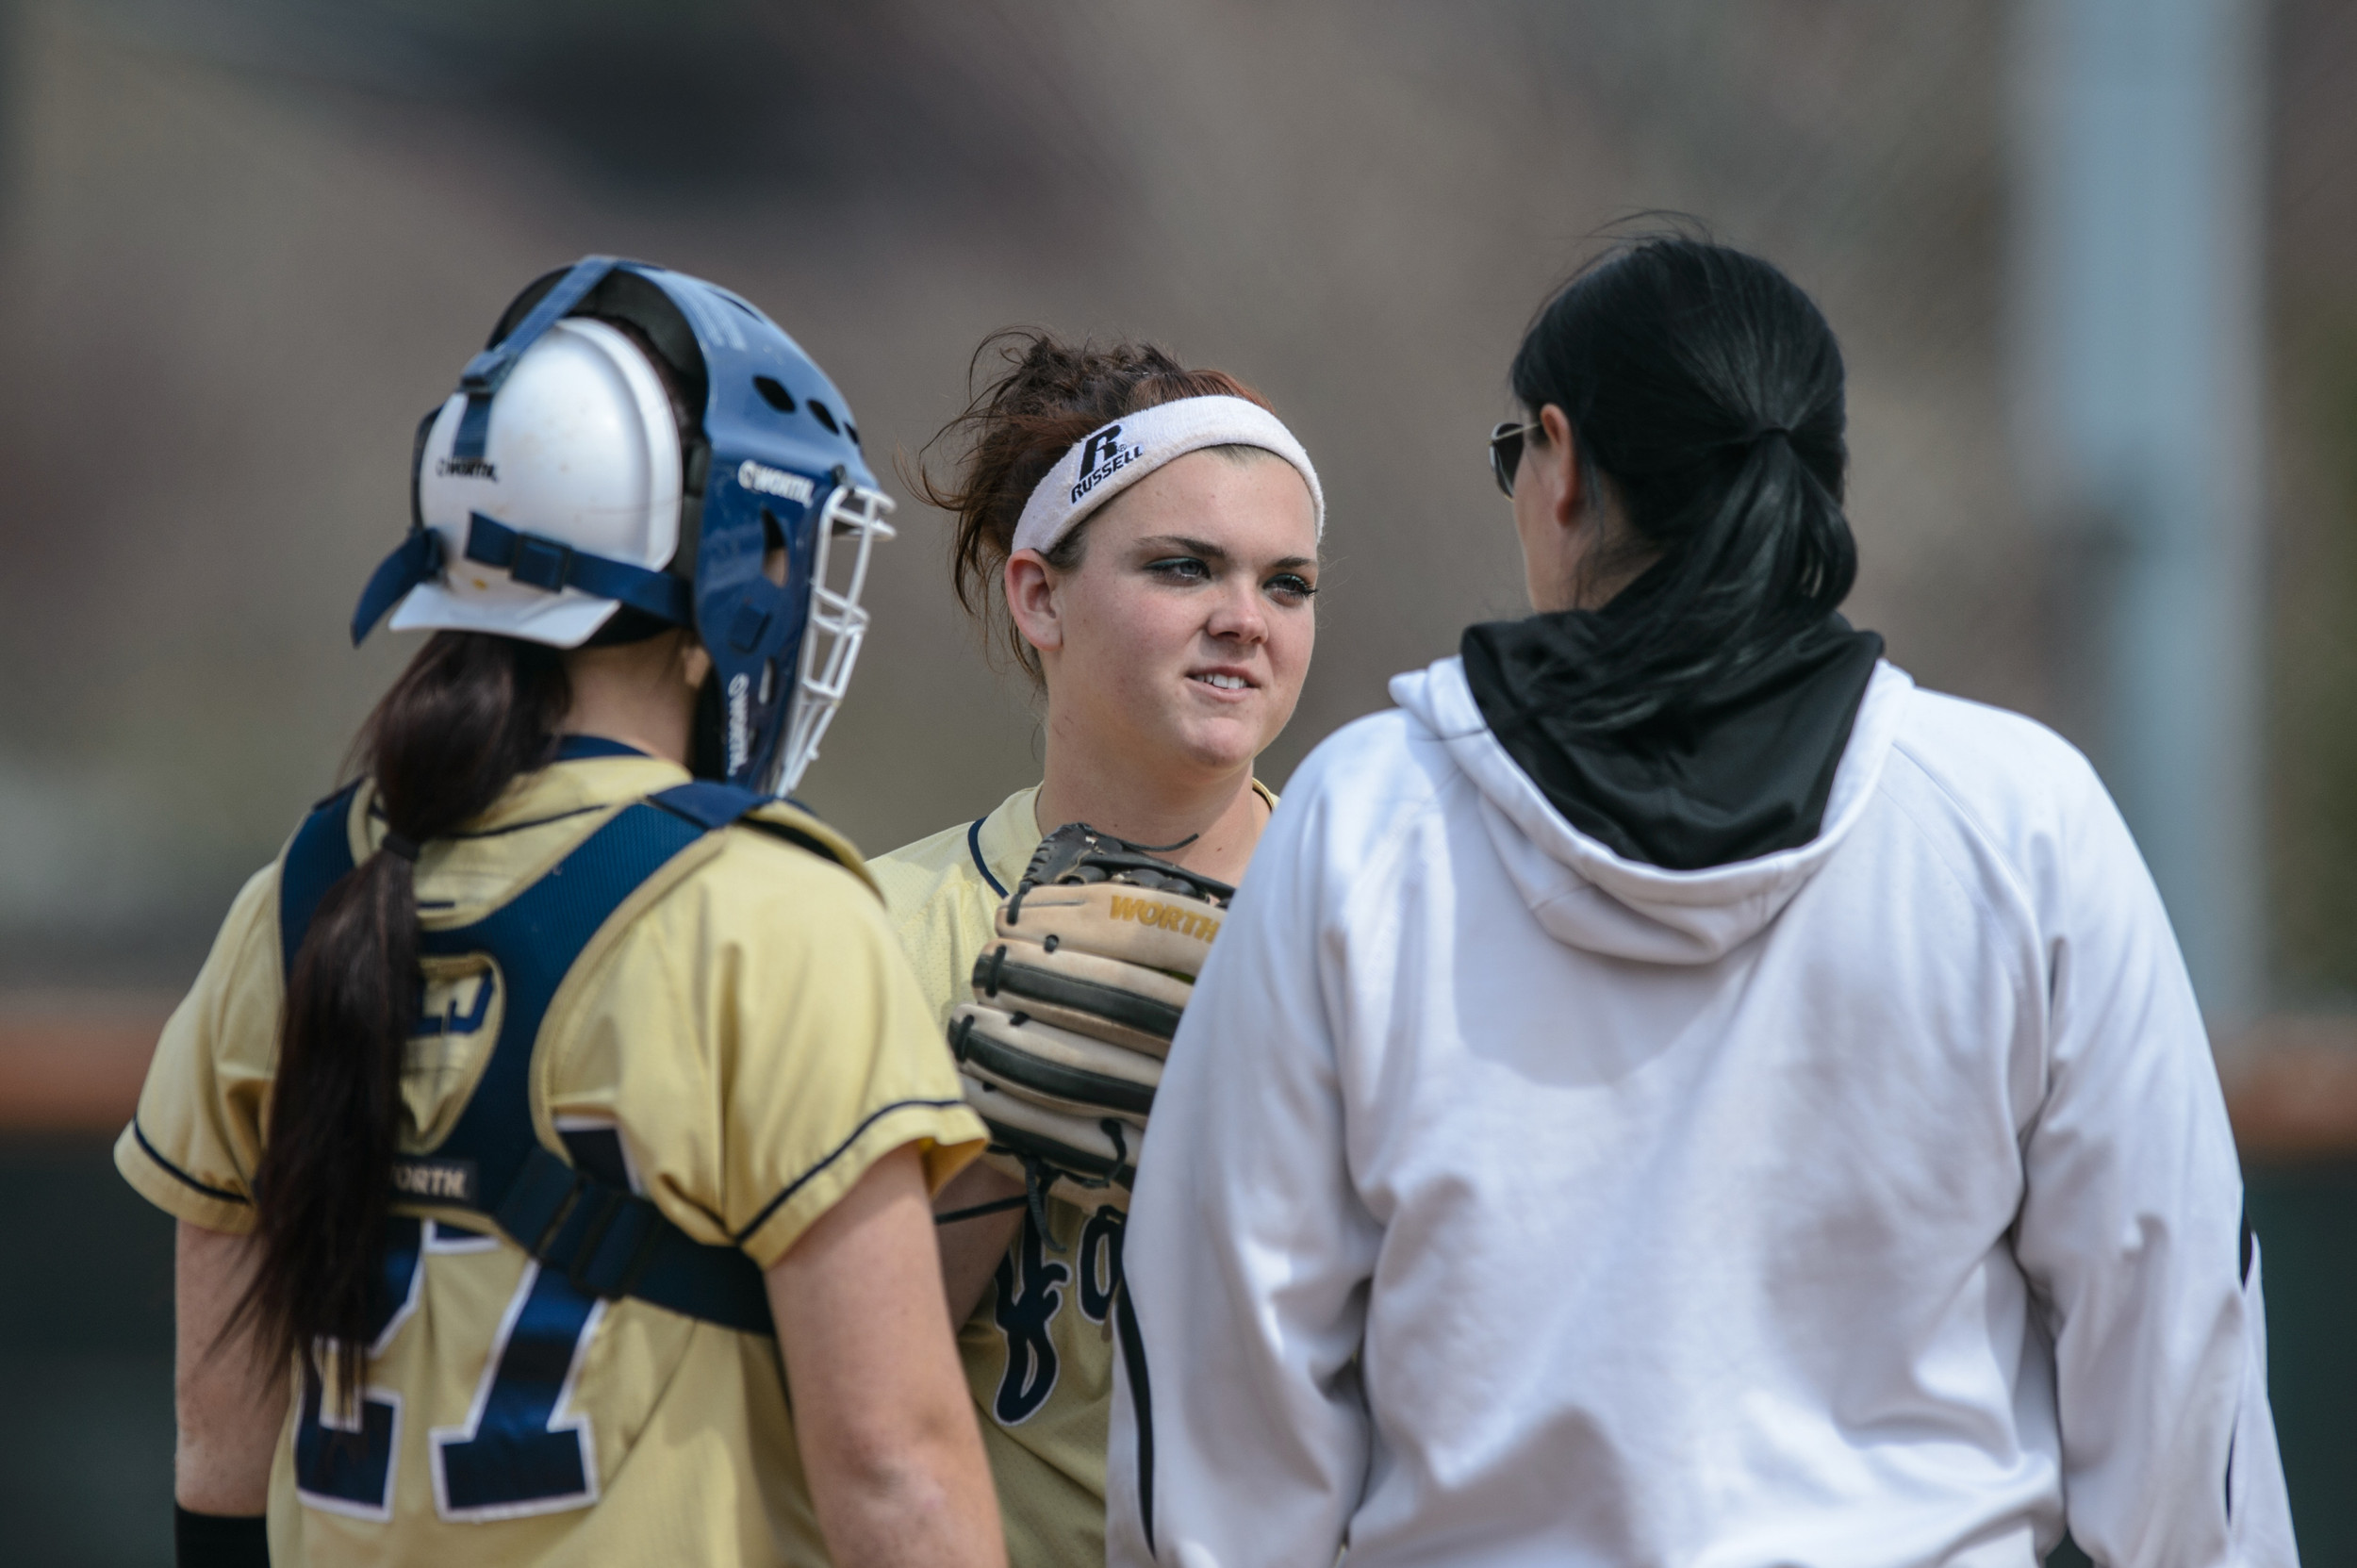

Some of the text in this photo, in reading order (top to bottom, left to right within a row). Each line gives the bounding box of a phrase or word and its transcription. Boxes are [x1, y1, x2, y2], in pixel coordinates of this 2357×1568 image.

[1071, 445, 1143, 504] RUSSELL
[1079, 424, 1122, 483] R
[753, 464, 815, 509] WORTH
[1110, 895, 1221, 944] WORTH
[391, 1164, 468, 1199] ORTH
